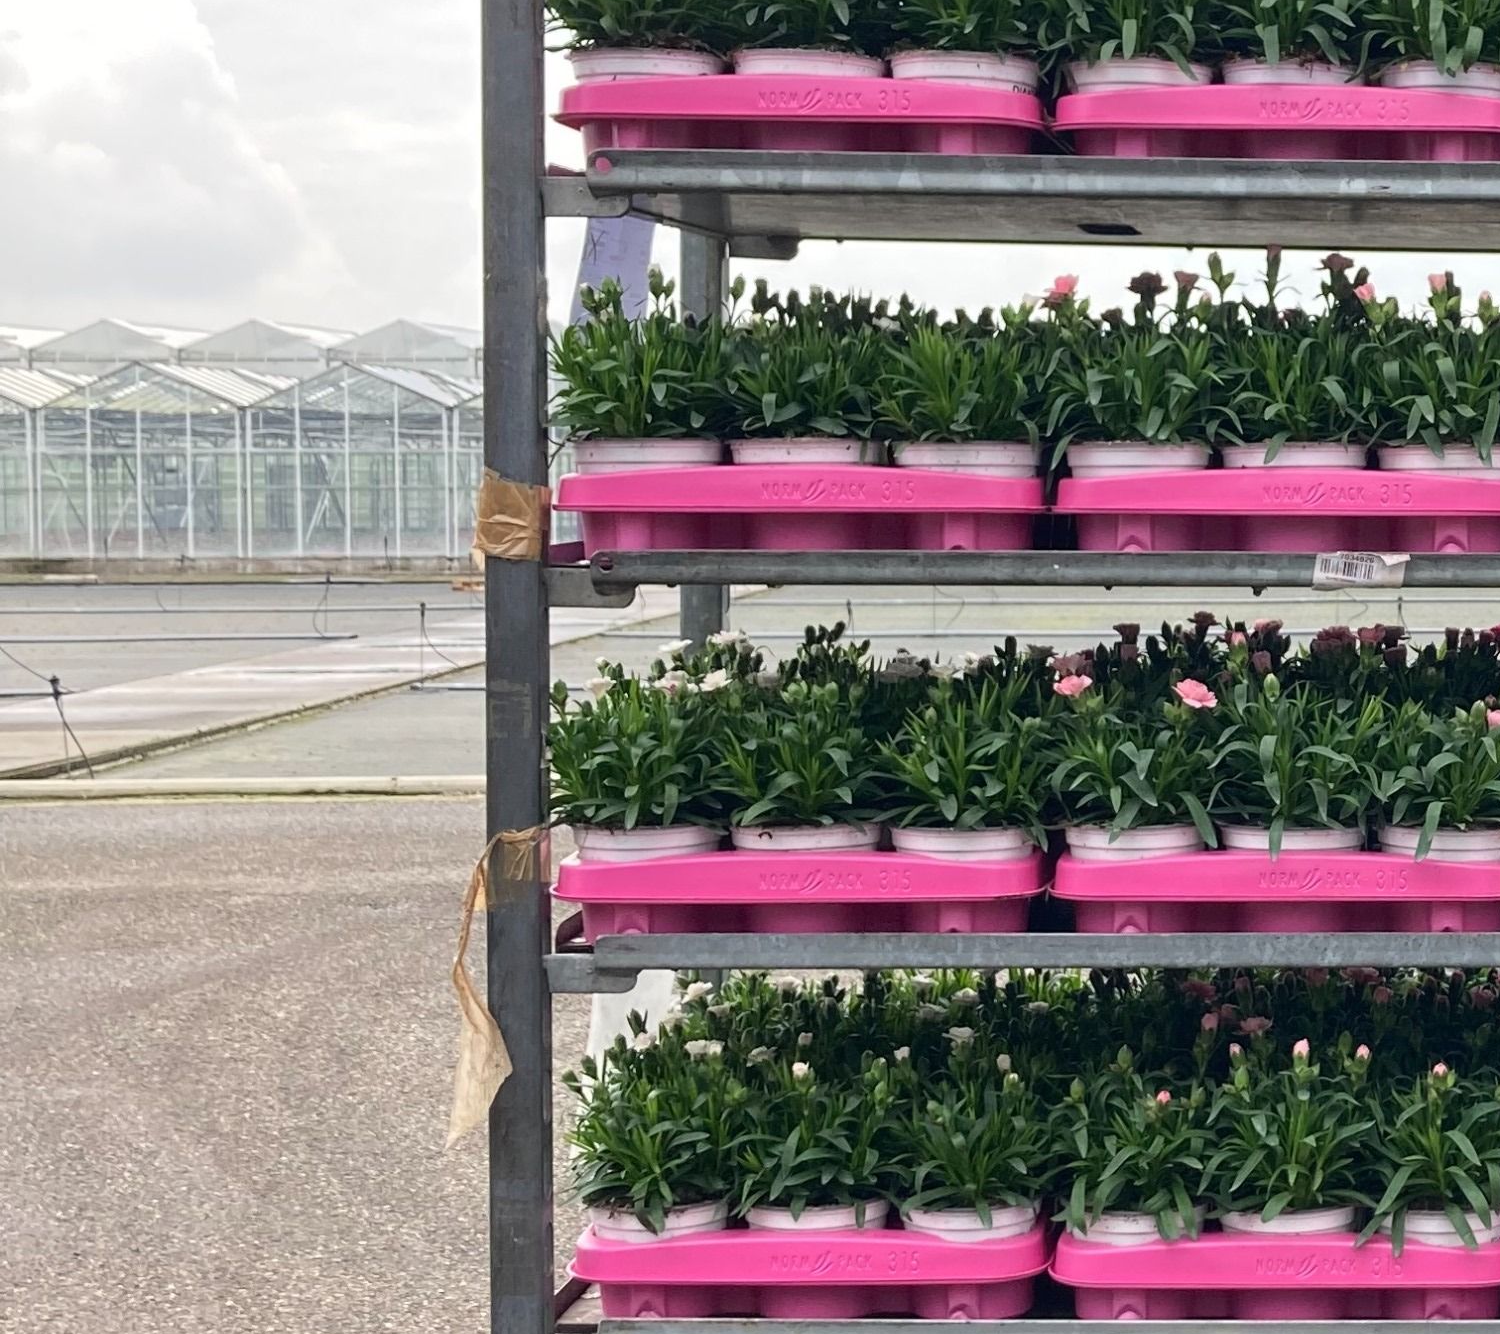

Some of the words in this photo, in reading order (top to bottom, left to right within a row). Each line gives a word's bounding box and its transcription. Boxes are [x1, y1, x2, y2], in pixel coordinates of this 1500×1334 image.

[758, 90, 799, 108] NORM
[827, 90, 862, 108] PACK
[879, 88, 911, 111] 315
[1260, 100, 1300, 118] NORM
[1328, 100, 1363, 118] PACK
[1377, 98, 1409, 120] 315
[762, 482, 801, 500] NORM
[830, 482, 866, 500] PACK
[882, 479, 914, 502] 315
[1263, 486, 1304, 502] NORM
[1331, 486, 1366, 502] PACK
[1381, 483, 1412, 504] 315
[759, 873, 799, 890] NORM
[827, 873, 862, 890] PACK
[879, 869, 912, 892] 315
[1259, 871, 1299, 888] NORM
[1326, 871, 1360, 888] PACK
[1376, 869, 1408, 891] 315
[770, 1254, 810, 1271] NORM
[838, 1254, 873, 1271] PACK
[888, 1250, 919, 1273] 315
